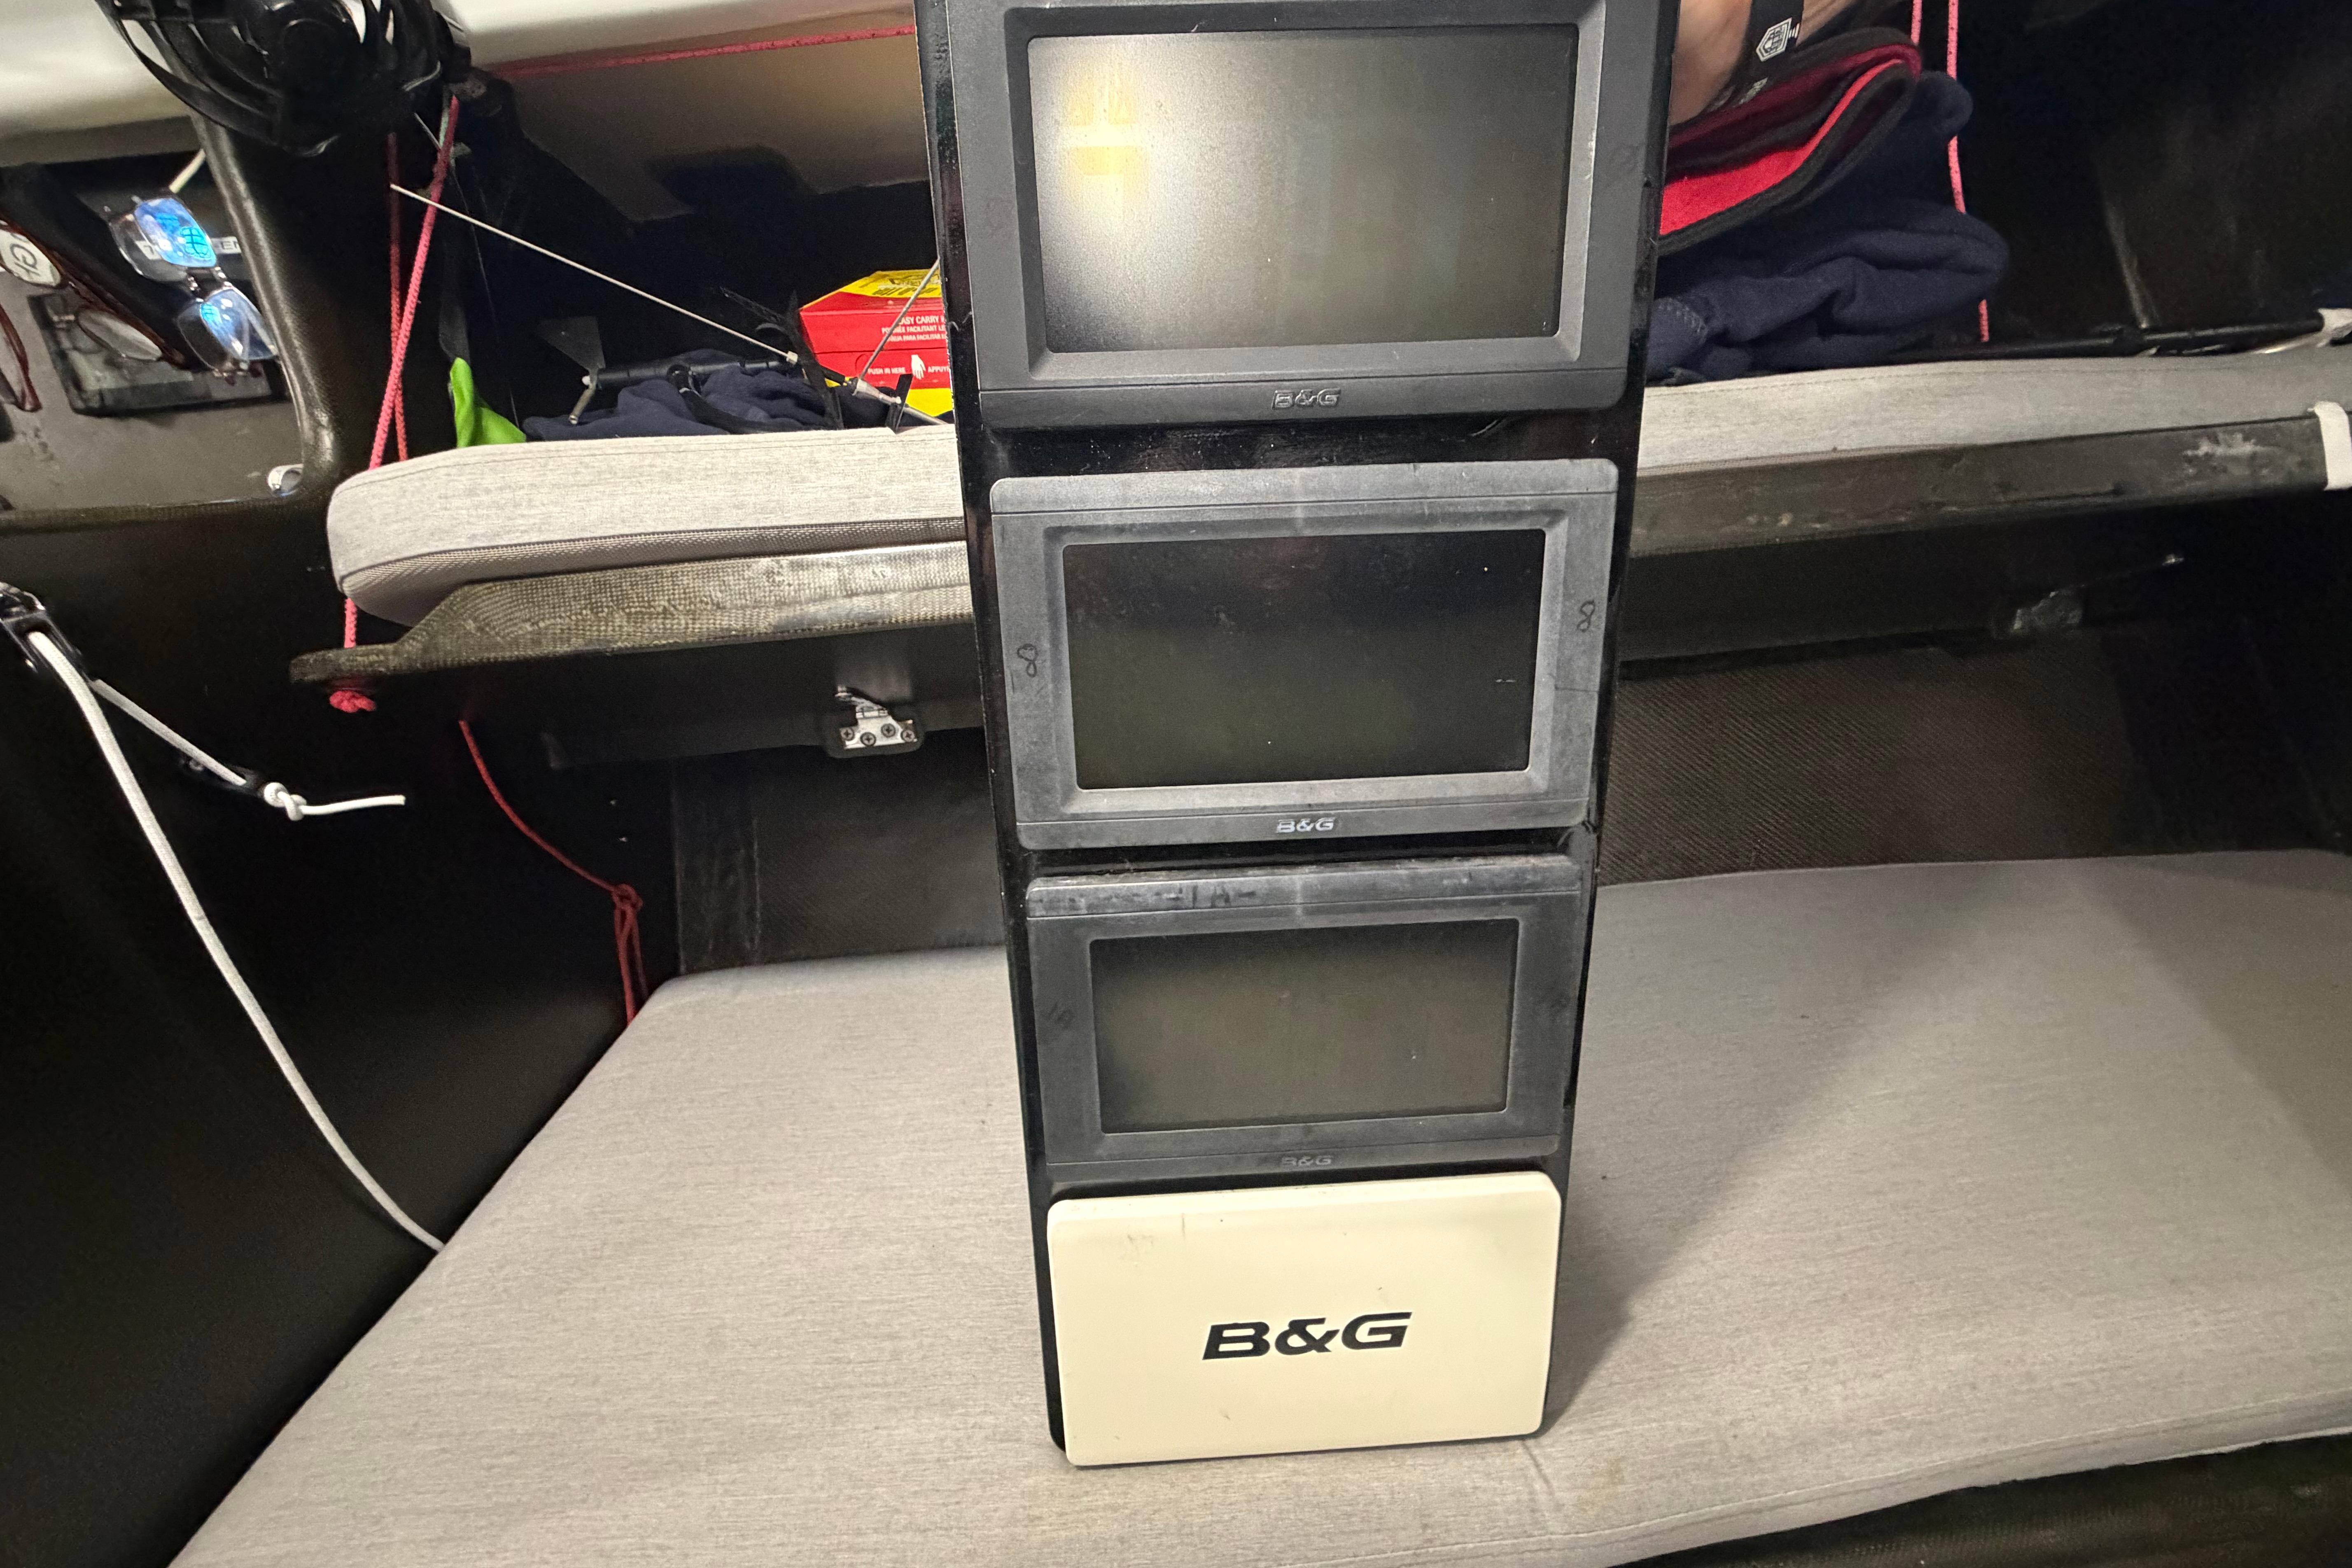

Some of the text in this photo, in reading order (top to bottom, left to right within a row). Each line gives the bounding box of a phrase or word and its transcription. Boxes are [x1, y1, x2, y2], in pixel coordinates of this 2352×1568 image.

[898, 316, 914, 325] ASY
[916, 316, 939, 324] CARRY
[1272, 387, 1342, 410] B&G
[1276, 817, 1336, 833] B&G
[1280, 1155, 1334, 1167] B&G
[1202, 1312, 1413, 1360] B&G
